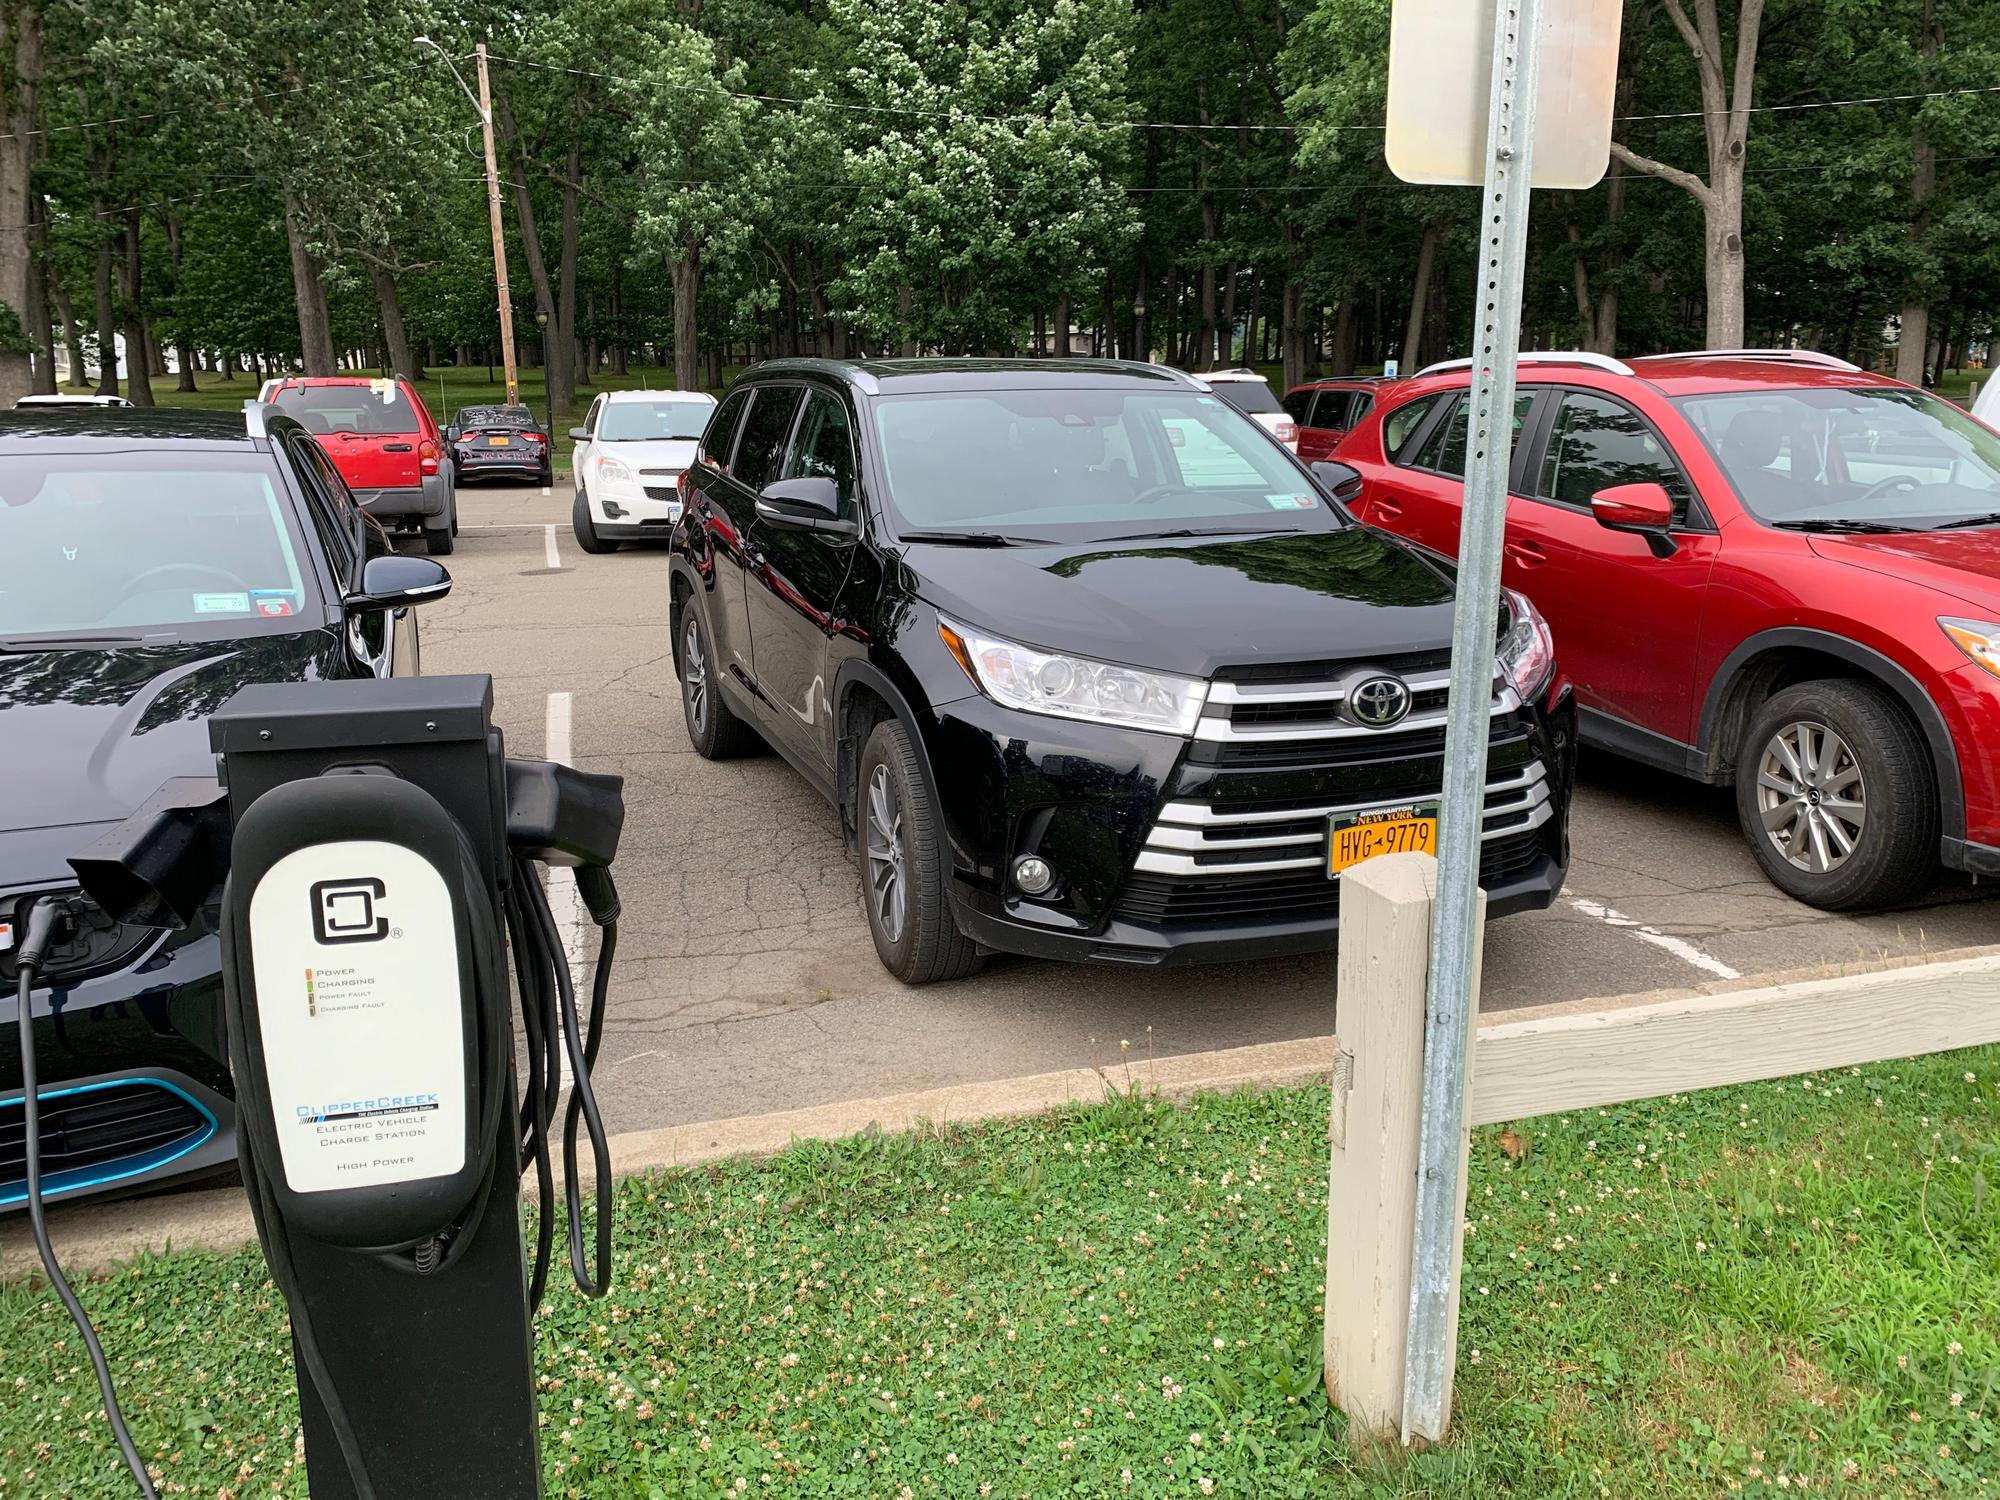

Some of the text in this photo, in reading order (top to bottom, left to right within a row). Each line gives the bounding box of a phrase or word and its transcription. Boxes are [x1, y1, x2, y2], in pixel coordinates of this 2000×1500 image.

[1358, 811, 1414, 825] NEW YORK
[1360, 805, 1414, 817] BINGHAMTON
[1341, 823, 1429, 862] HVG 9779
[315, 968, 356, 977] POWER
[317, 978, 376, 989] CHARGING
[318, 991, 372, 1001] POWER FAULT
[296, 1093, 439, 1116] CLIPPERCREEK
[316, 1115, 428, 1134] ELECTRIC VEHICLE
[320, 1129, 426, 1147] CHARGE STATION
[336, 1156, 415, 1171] HIGH POWER
